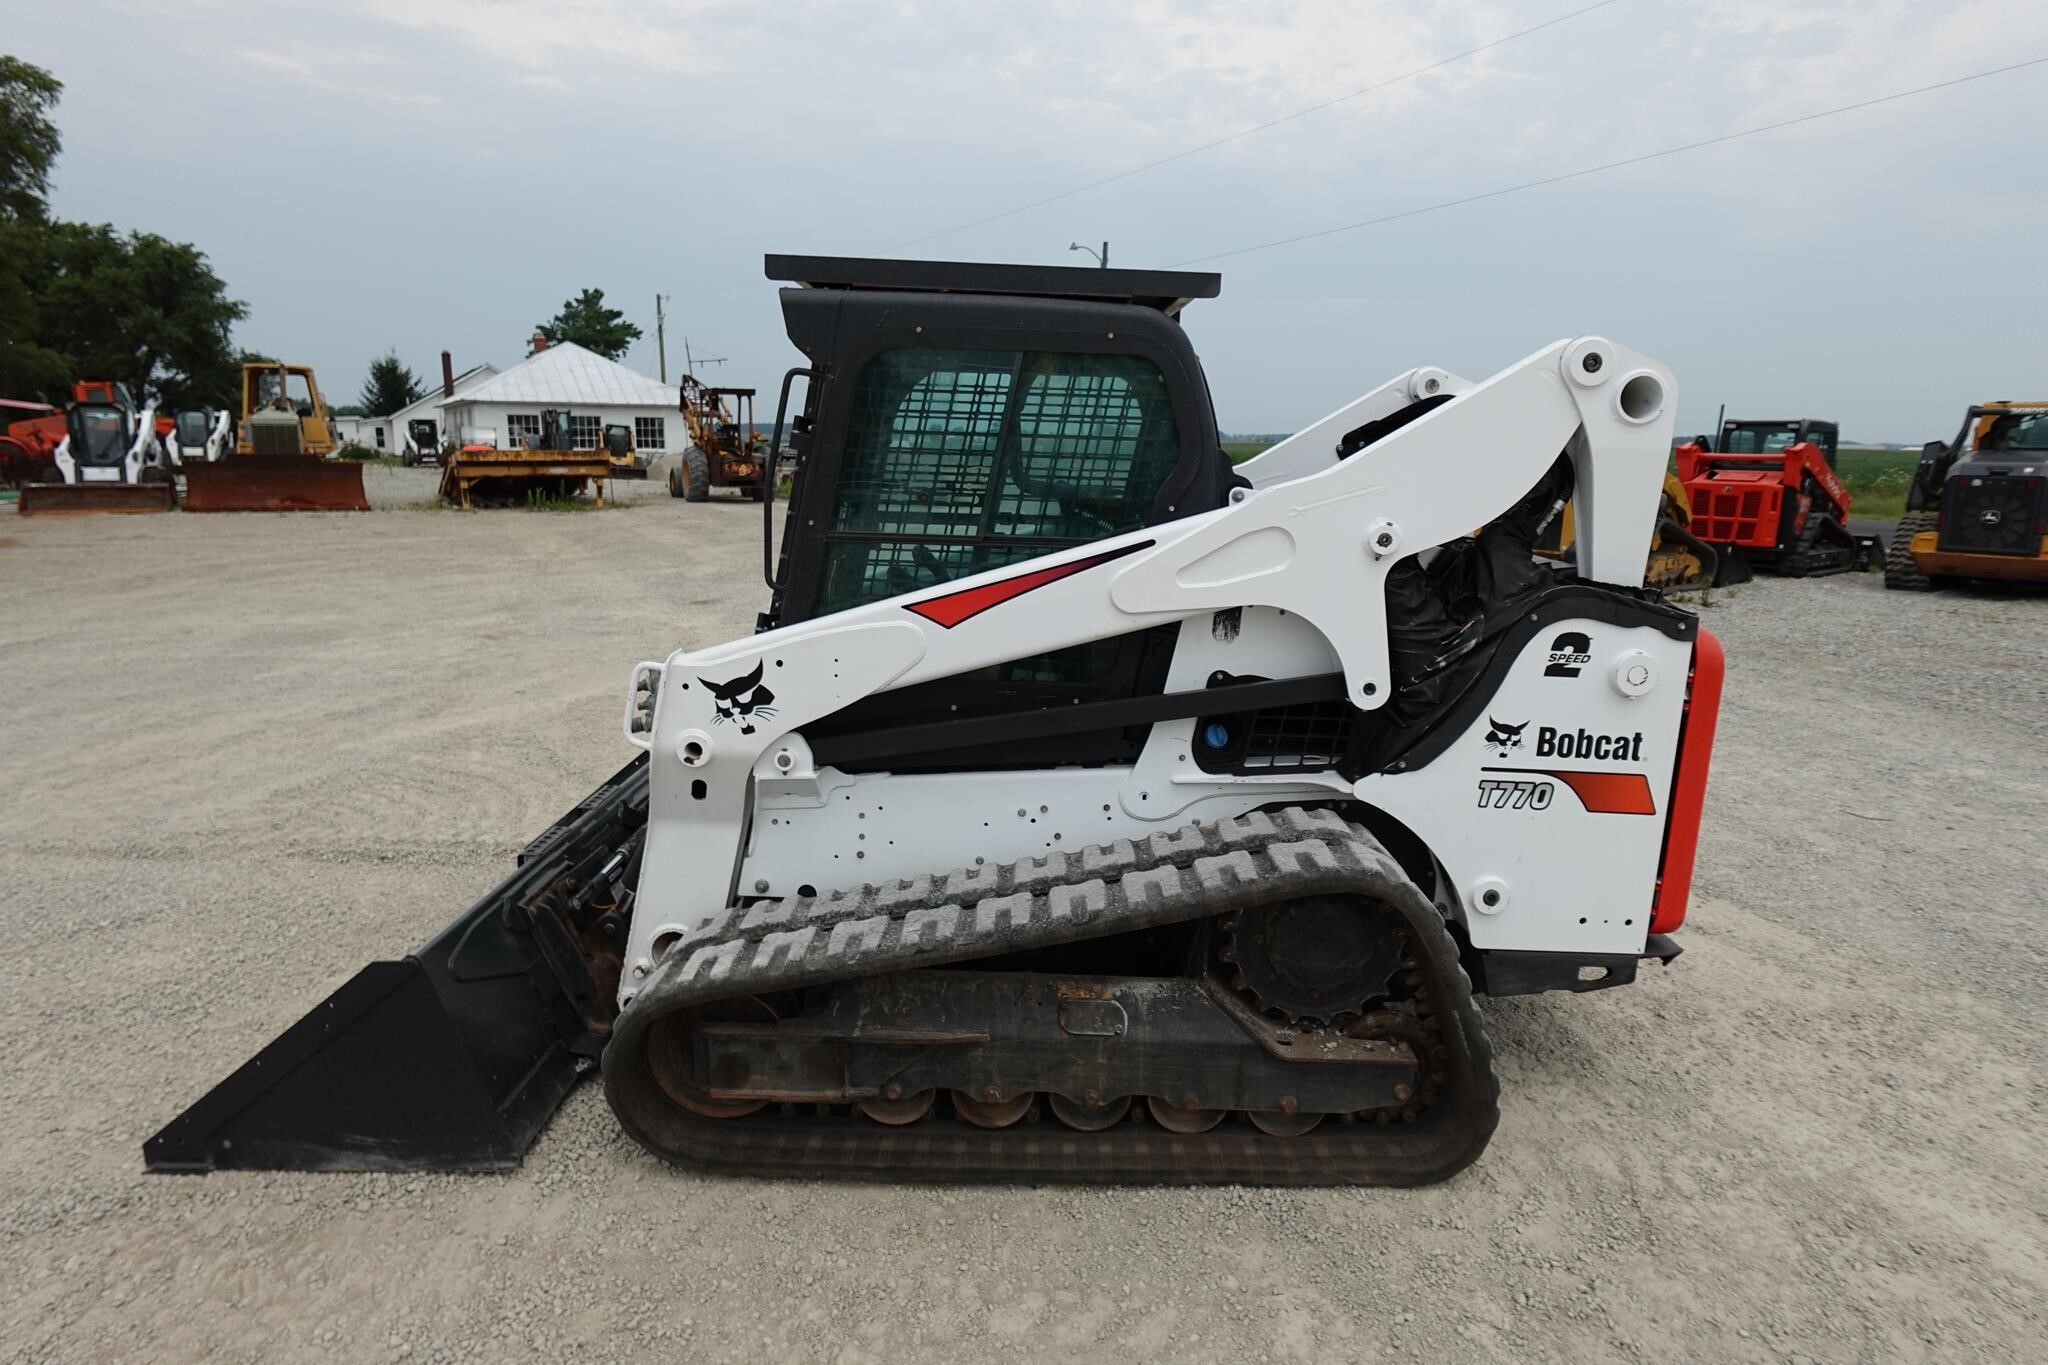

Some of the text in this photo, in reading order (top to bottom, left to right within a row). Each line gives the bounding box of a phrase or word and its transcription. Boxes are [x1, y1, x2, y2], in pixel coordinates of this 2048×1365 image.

[1544, 632, 1591, 678] 2
[1548, 653, 1591, 663] SPEED
[1536, 726, 1643, 761] Bobcat
[1477, 780, 1555, 810] T770
